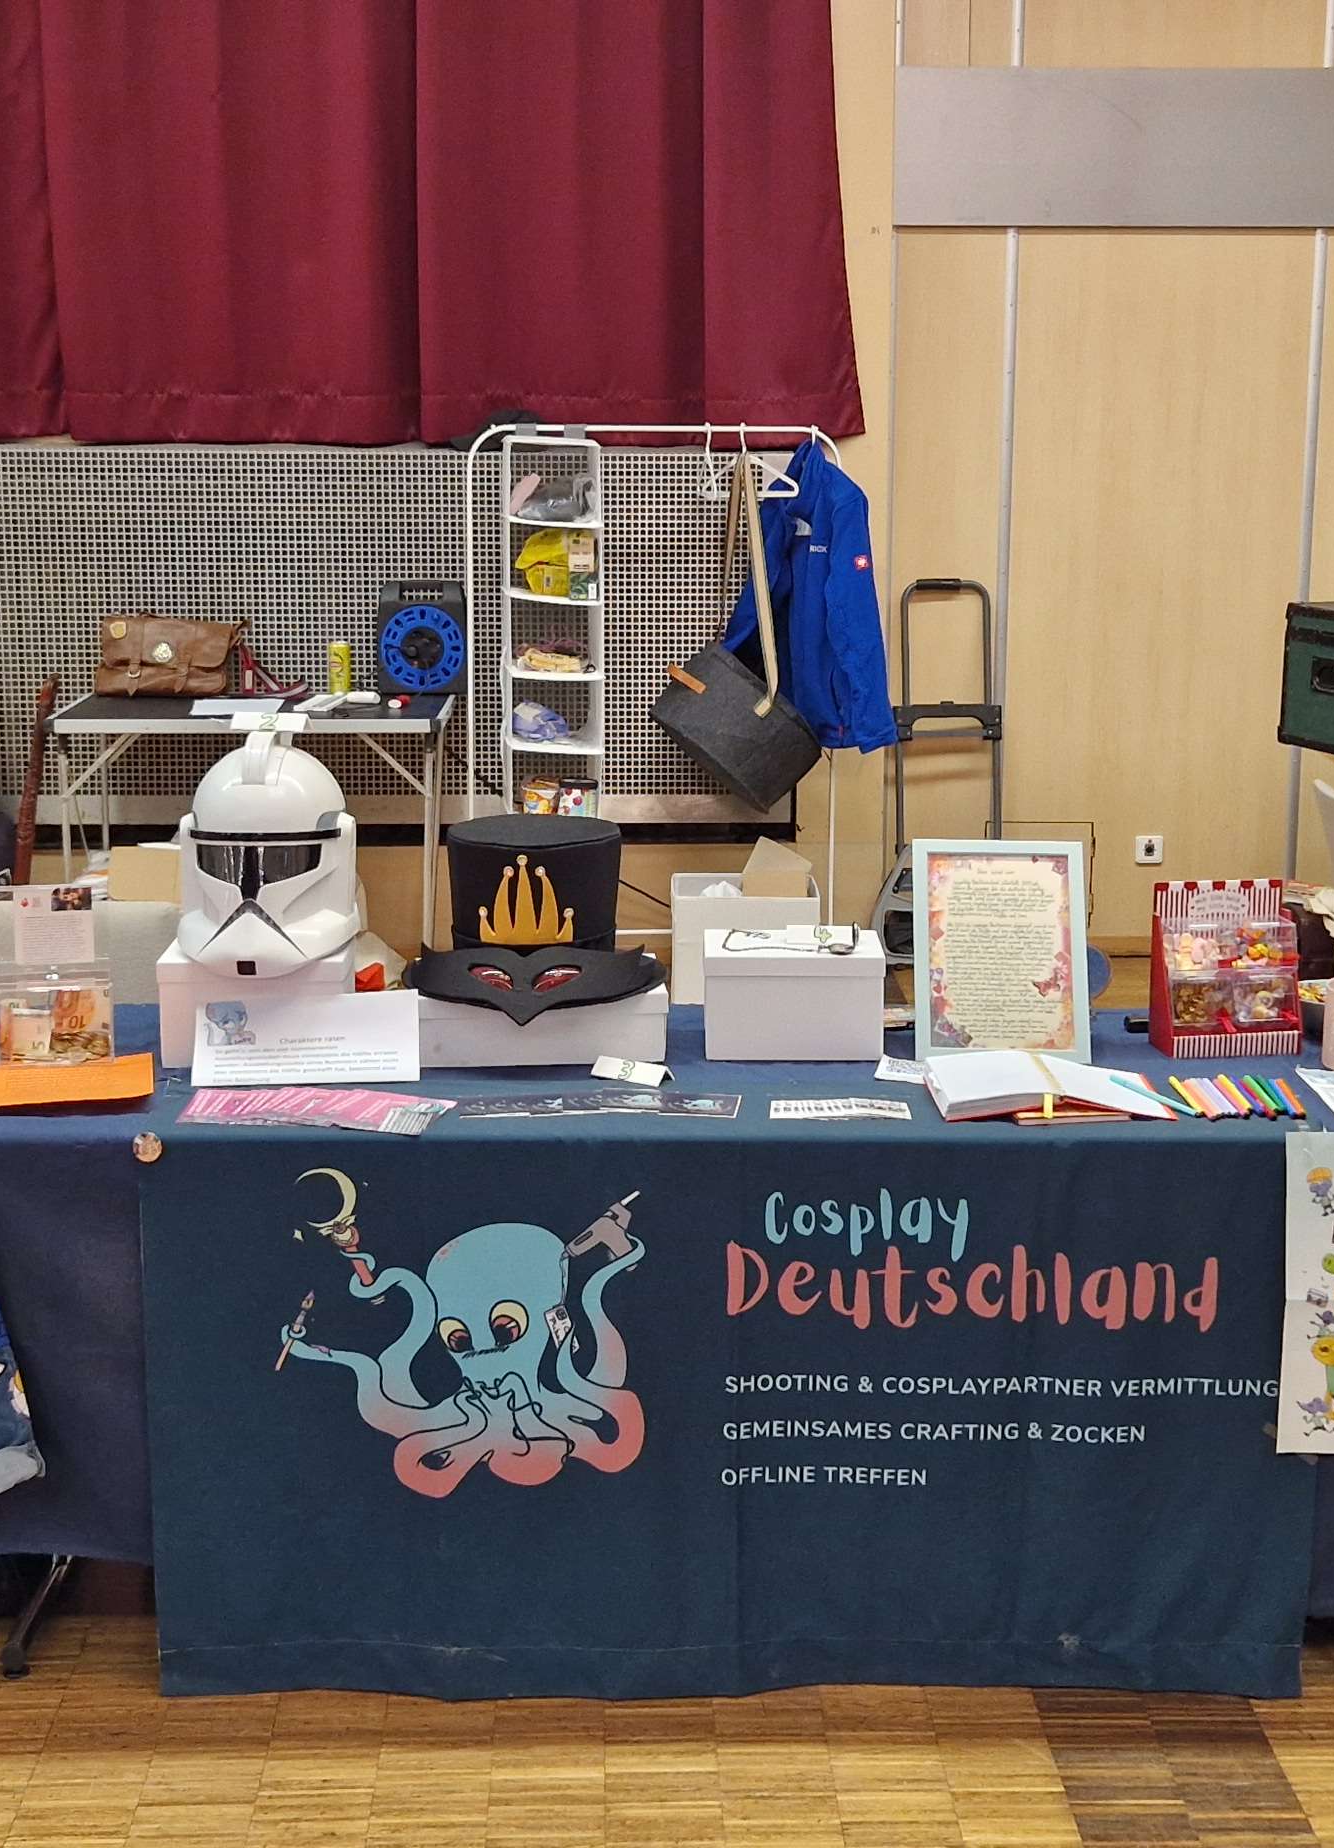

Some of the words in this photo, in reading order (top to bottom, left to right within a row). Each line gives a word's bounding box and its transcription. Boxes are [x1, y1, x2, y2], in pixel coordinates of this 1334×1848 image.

[258, 711, 279, 731] 2
[813, 926, 833, 943] 4
[617, 1059, 636, 1080] 3
[765, 1187, 970, 1263] Cosplay
[725, 1240, 1220, 1334] Deutschland
[724, 1373, 850, 1396] SHOOTING
[857, 1375, 875, 1395] &
[881, 1375, 1103, 1398] COSPLAYPARTNER
[1110, 1378, 1280, 1399] VERMITTLUNG
[722, 1420, 893, 1442] GEMEINSAMES
[898, 1422, 1020, 1443] CRAFTING
[1026, 1422, 1045, 1441] &
[1050, 1424, 1147, 1444] ZOCKEN
[720, 1465, 817, 1487] OFFLINE
[822, 1466, 928, 1488] TREFFEN
